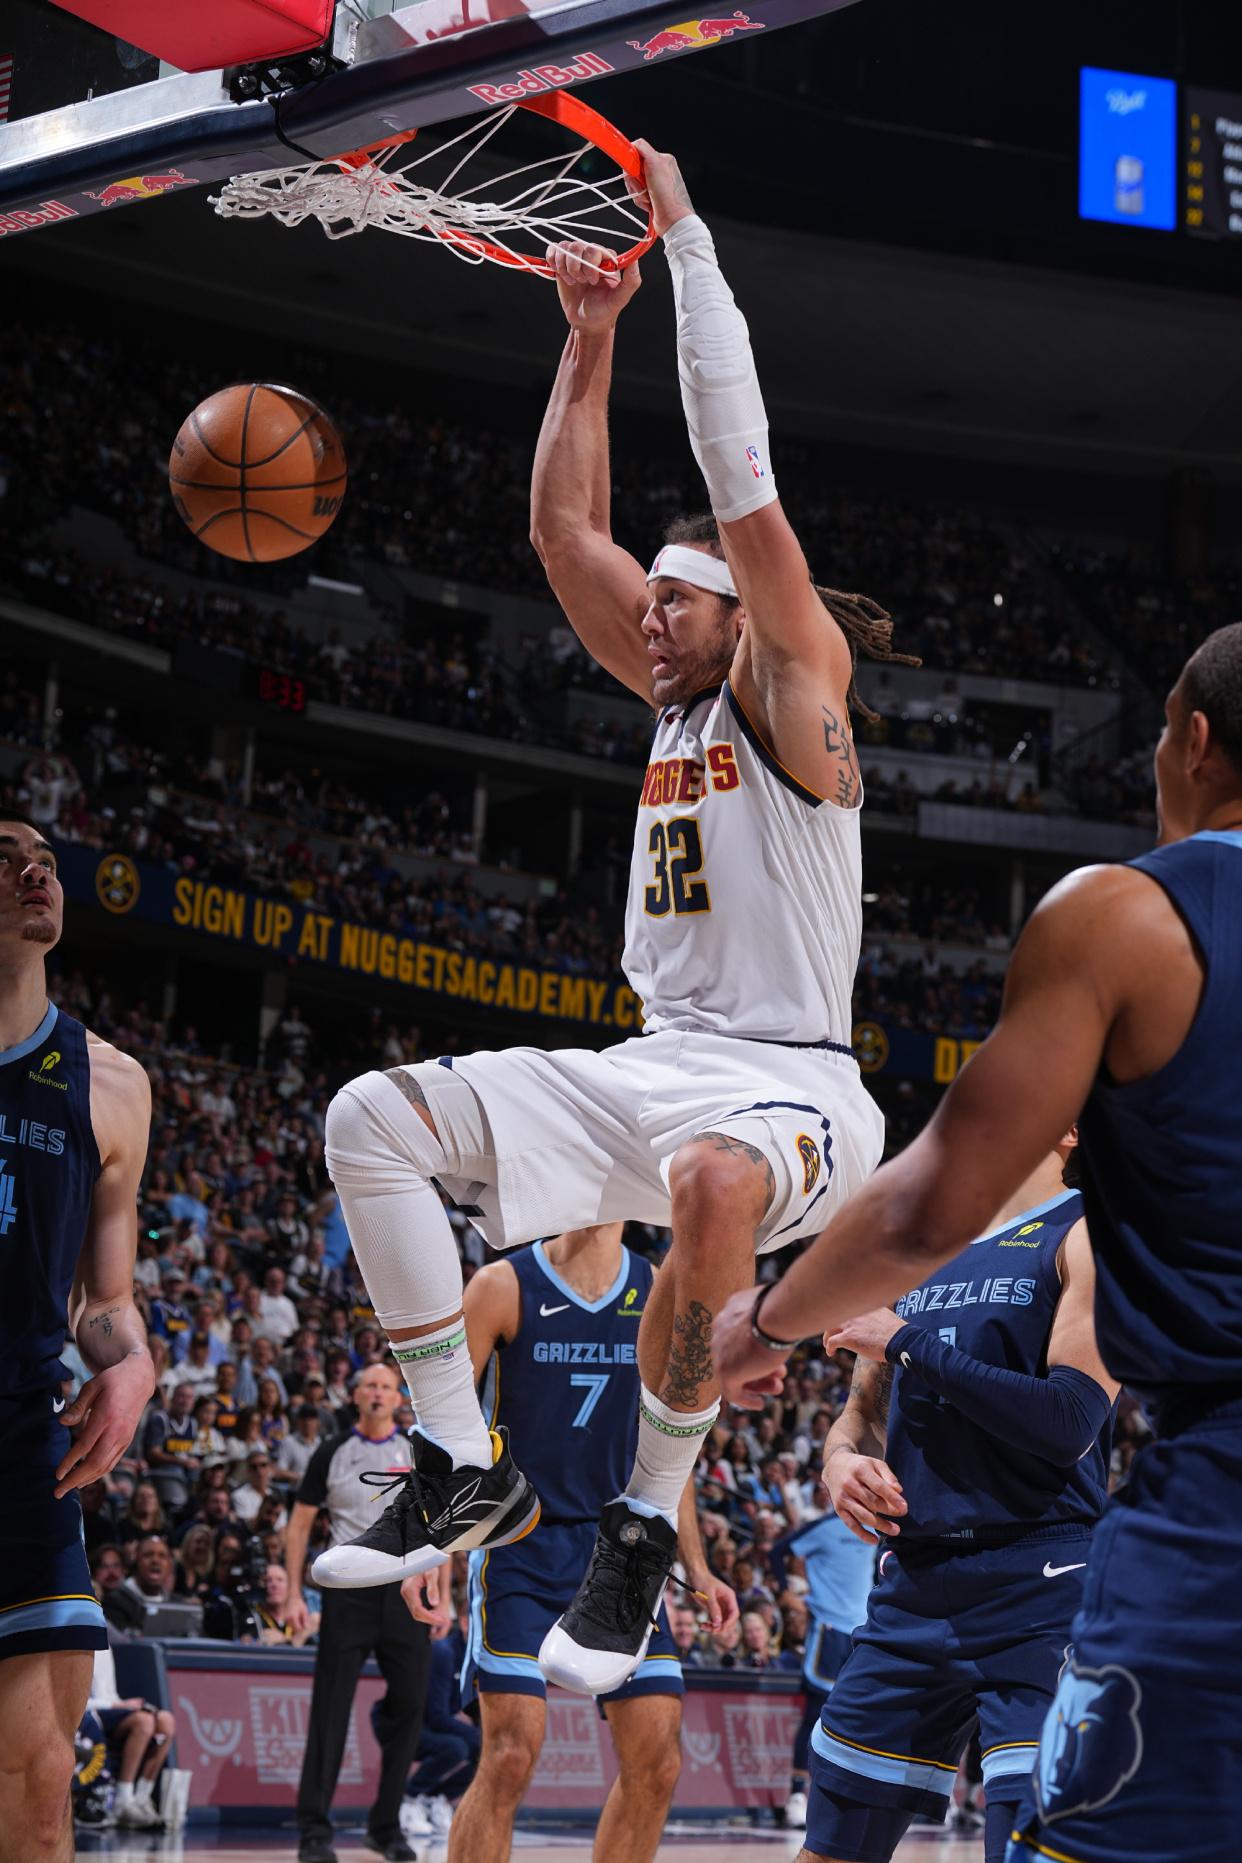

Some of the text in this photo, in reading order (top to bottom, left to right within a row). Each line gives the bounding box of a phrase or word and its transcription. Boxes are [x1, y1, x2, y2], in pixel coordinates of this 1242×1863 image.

[643, 815, 712, 919] 32
[172, 876, 645, 1030] SIGN UP AT NUGGETSACADEMY.C
[29, 1070, 68, 1091] Robinhood
[998, 1239, 1041, 1249] Robinhood
[895, 1276, 1036, 1319] GRIZZLIES
[533, 1341, 638, 1364] GRIZZLIE
[569, 1373, 611, 1428] 7
